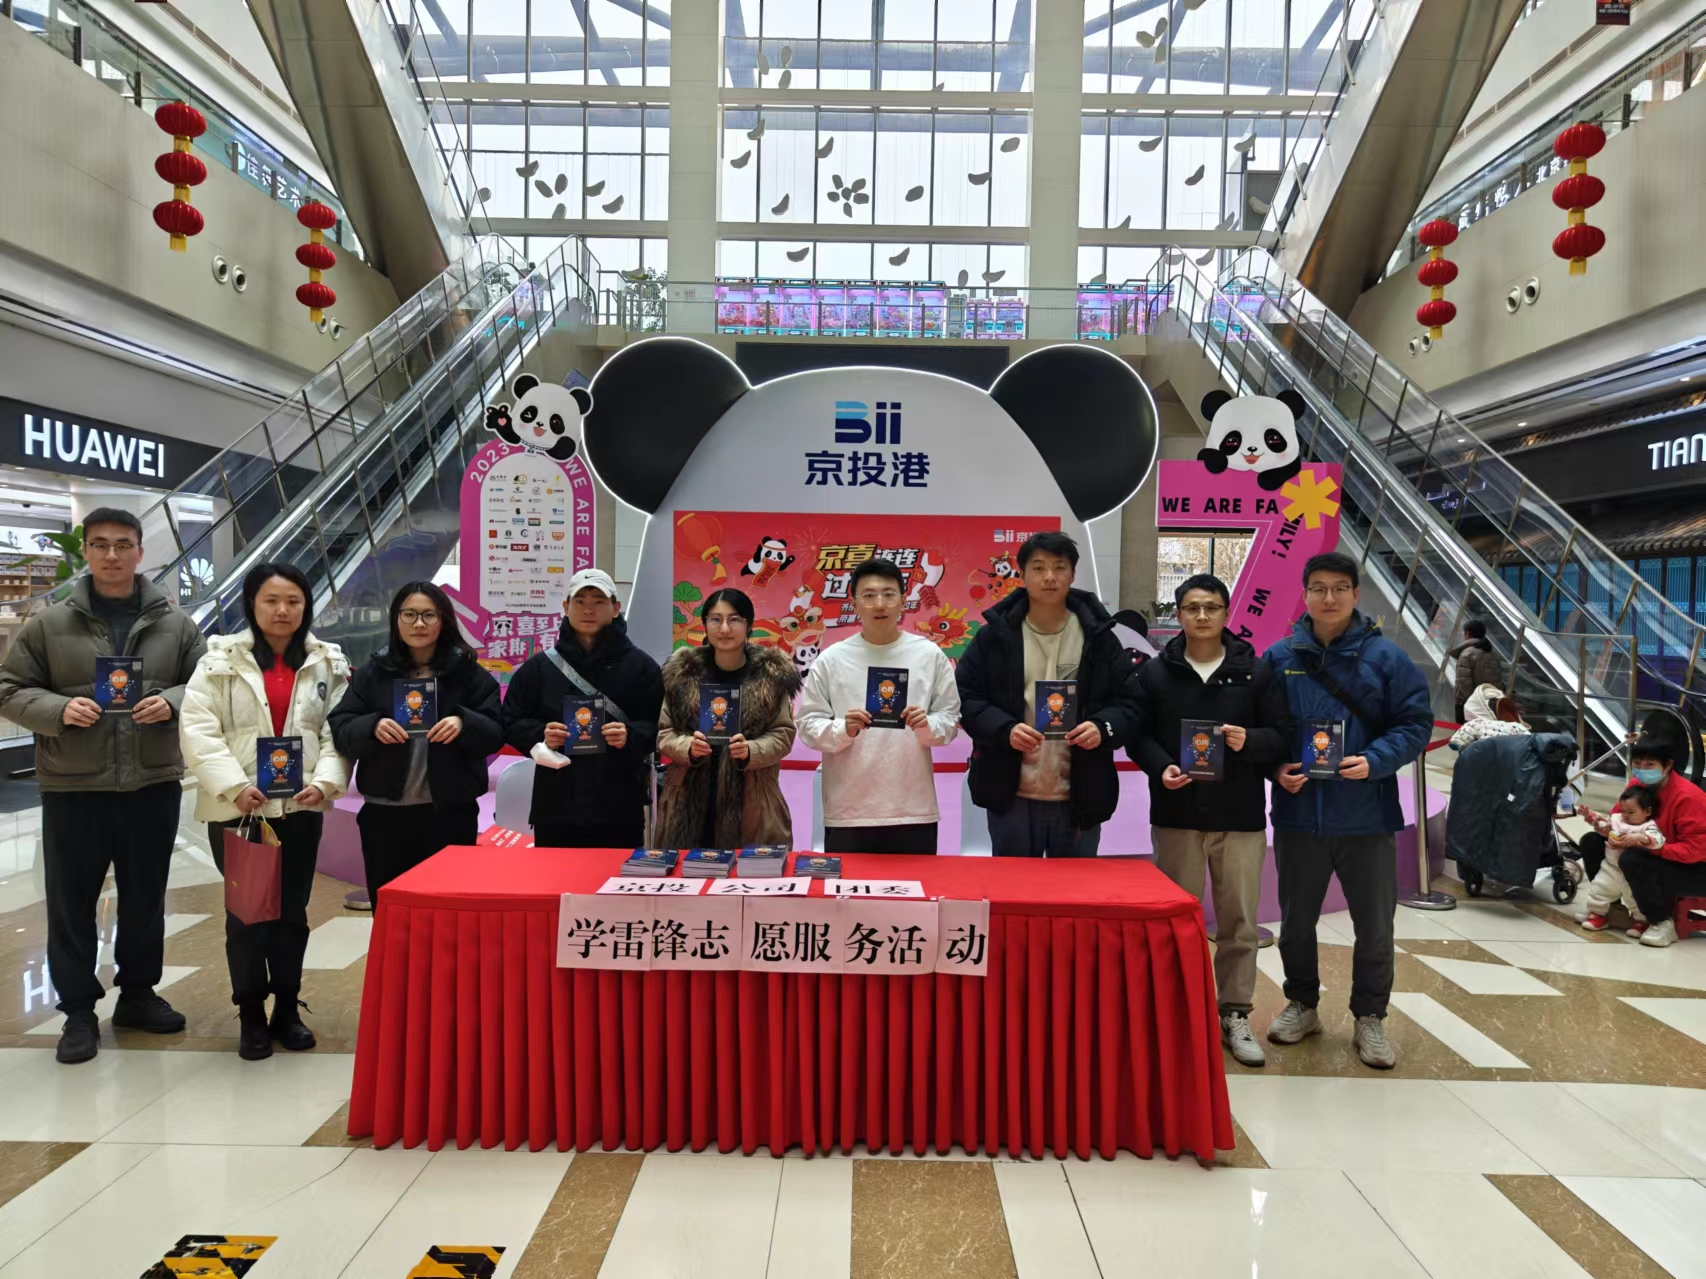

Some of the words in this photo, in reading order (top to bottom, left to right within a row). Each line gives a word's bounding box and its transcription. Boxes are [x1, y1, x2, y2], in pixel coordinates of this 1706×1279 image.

[24, 413, 164, 478] HUAWEI
[470, 442, 510, 483] 2023
[804, 450, 930, 488] 京投港
[564, 459, 588, 489] WE
[576, 498, 590, 536] ARE
[1162, 497, 1191, 513] WE
[1203, 498, 1242, 513] ARE
[1247, 588, 1272, 617] WE
[615, 882, 692, 893] 京投
[721, 883, 797, 894] 公司
[567, 917, 987, 965] 学雷锋志愿服务活动
